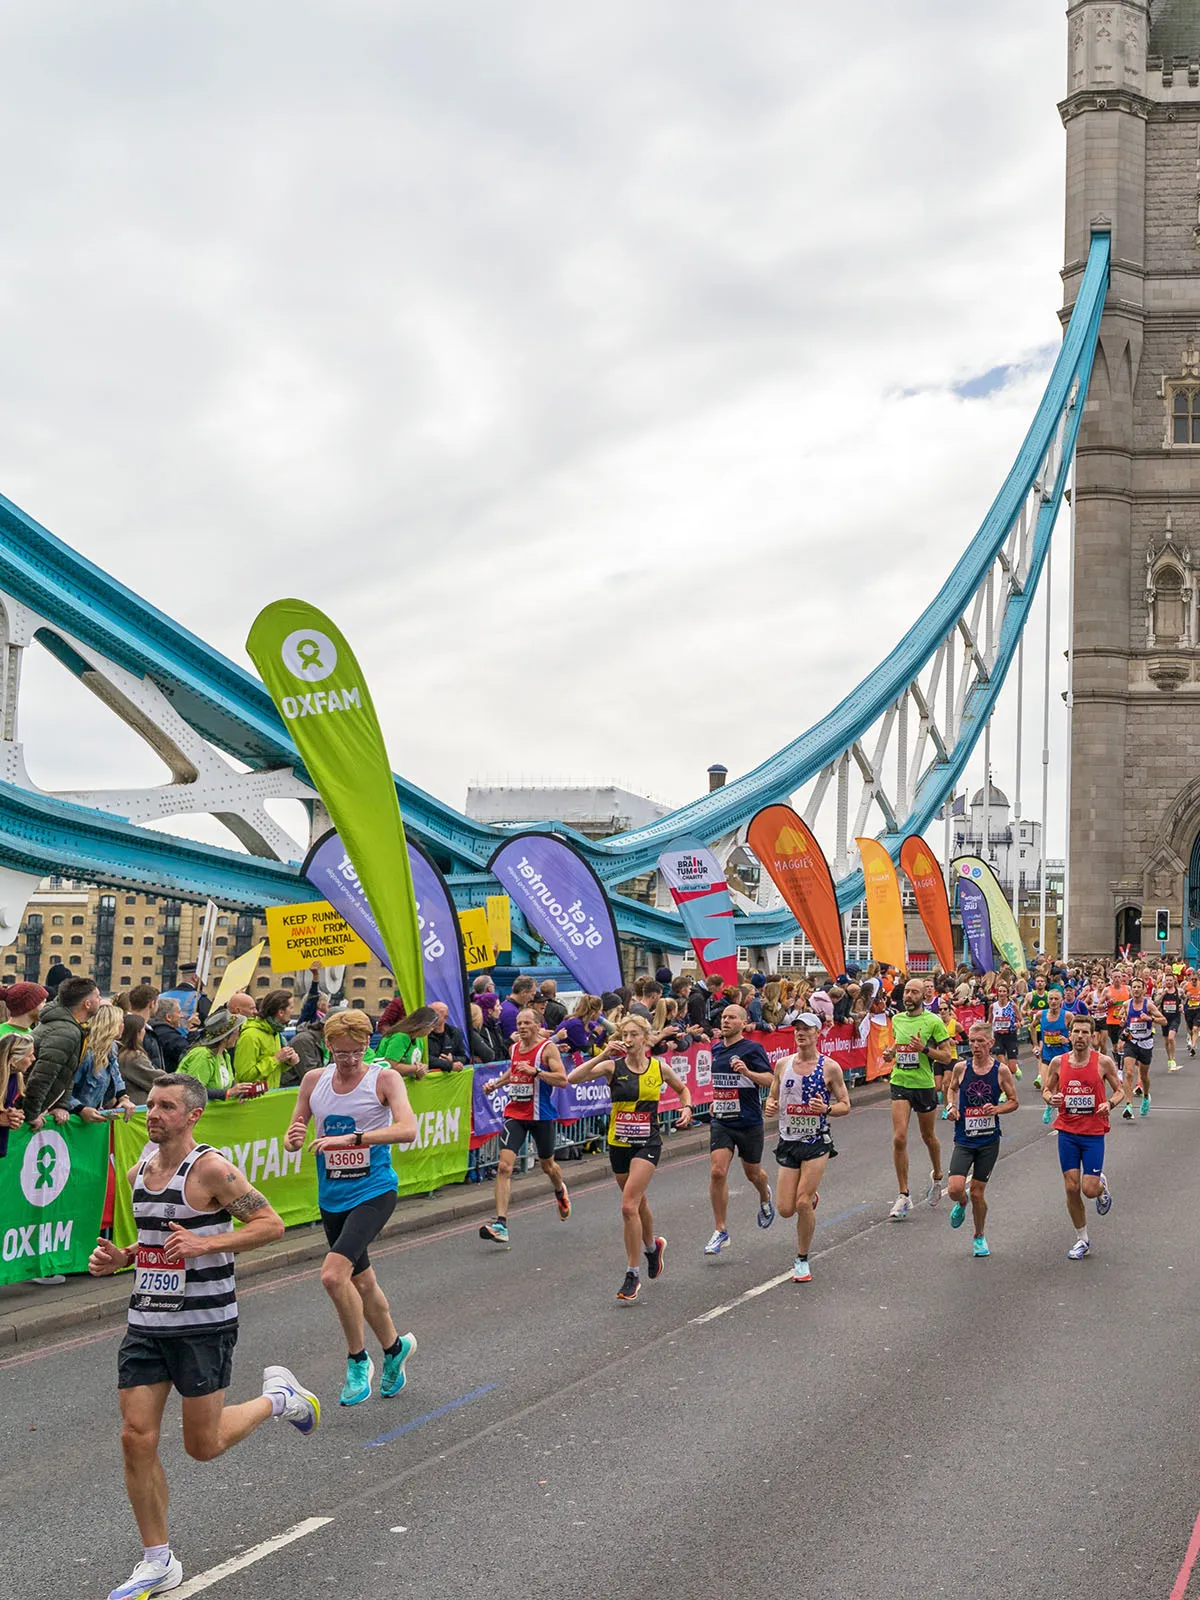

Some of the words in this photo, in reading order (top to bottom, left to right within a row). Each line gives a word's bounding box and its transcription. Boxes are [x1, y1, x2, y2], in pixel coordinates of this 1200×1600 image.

[281, 687, 362, 720] OXFAM
[283, 914, 308, 926] KEEP
[291, 926, 317, 937] AWAY
[323, 922, 348, 933] FROM
[286, 933, 355, 949] EXPERIMENTAL
[766, 1047, 790, 1063] arathon
[1069, 1097, 1092, 1106] 26366
[617, 1112, 649, 1121] MONEY
[790, 1117, 817, 1126] 35316
[329, 1152, 364, 1166] 43609
[140, 1273, 179, 1291] 27590
